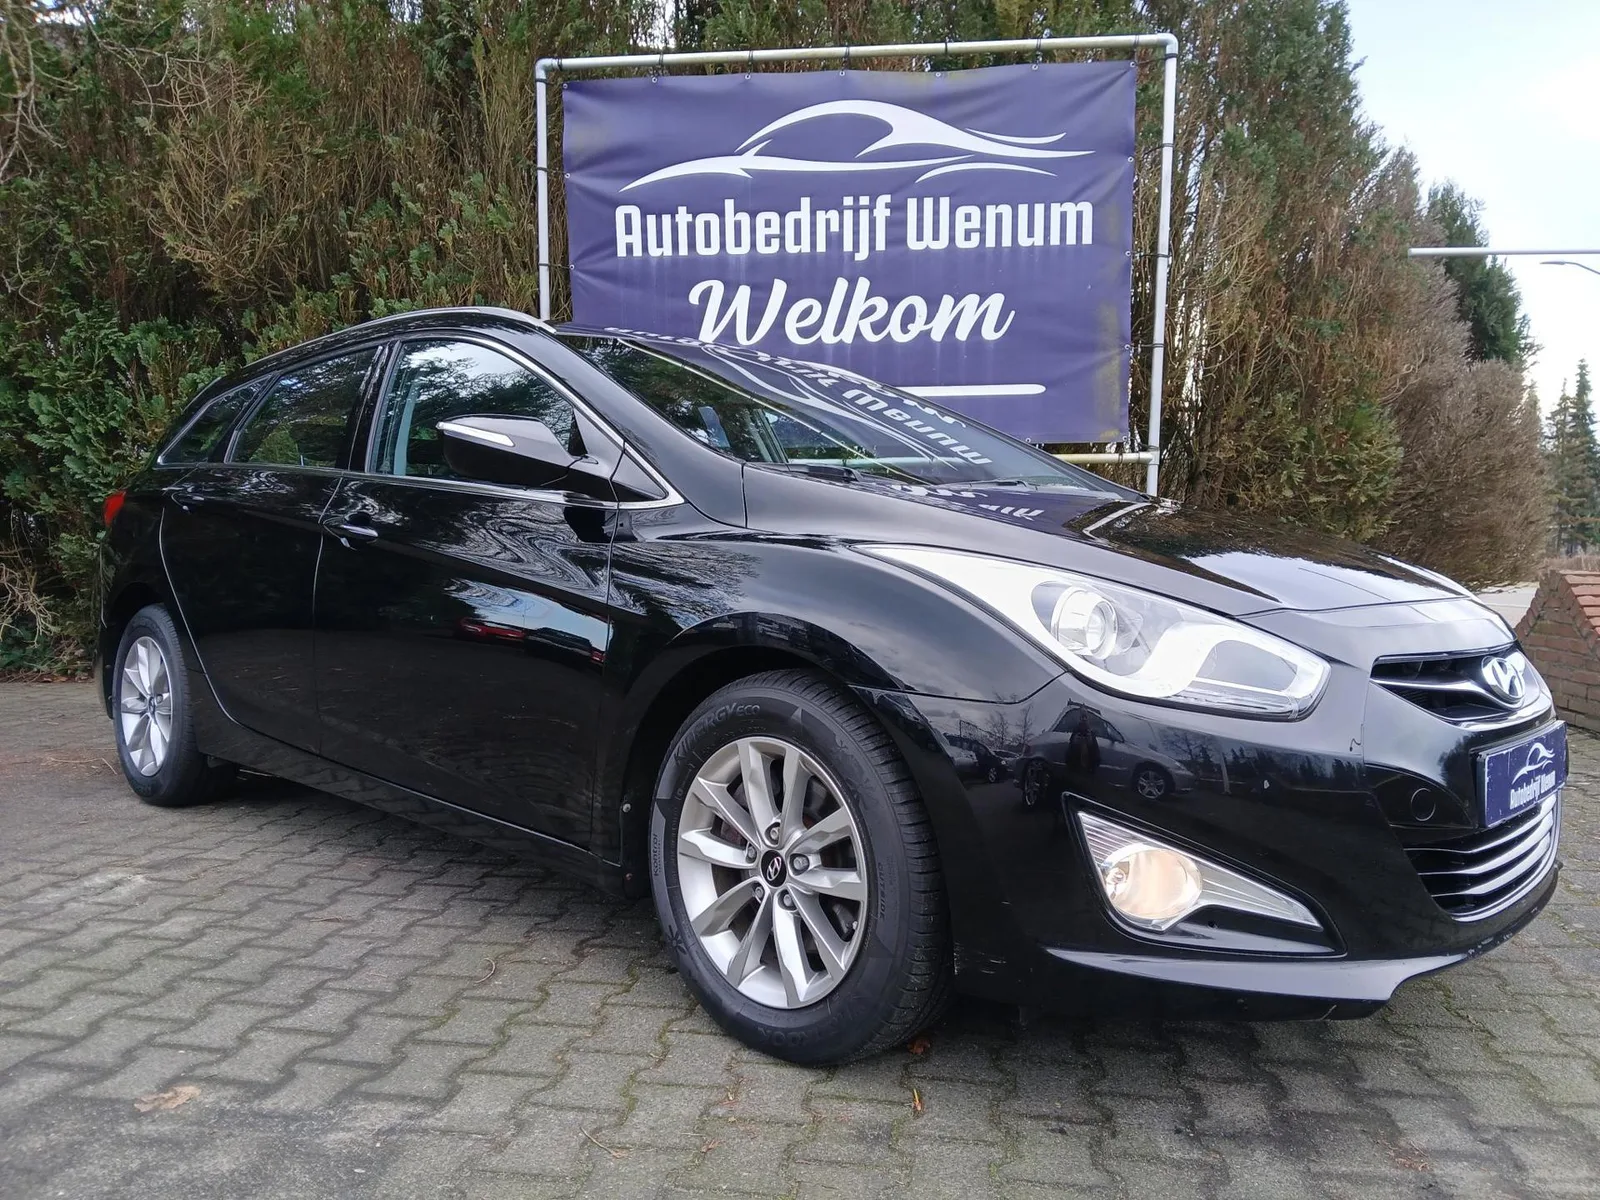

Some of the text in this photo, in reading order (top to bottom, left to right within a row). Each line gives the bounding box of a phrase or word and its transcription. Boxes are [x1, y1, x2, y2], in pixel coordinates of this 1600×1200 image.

[614, 194, 1094, 261] Autobedrijf Wenum
[689, 276, 1016, 346] Welkom
